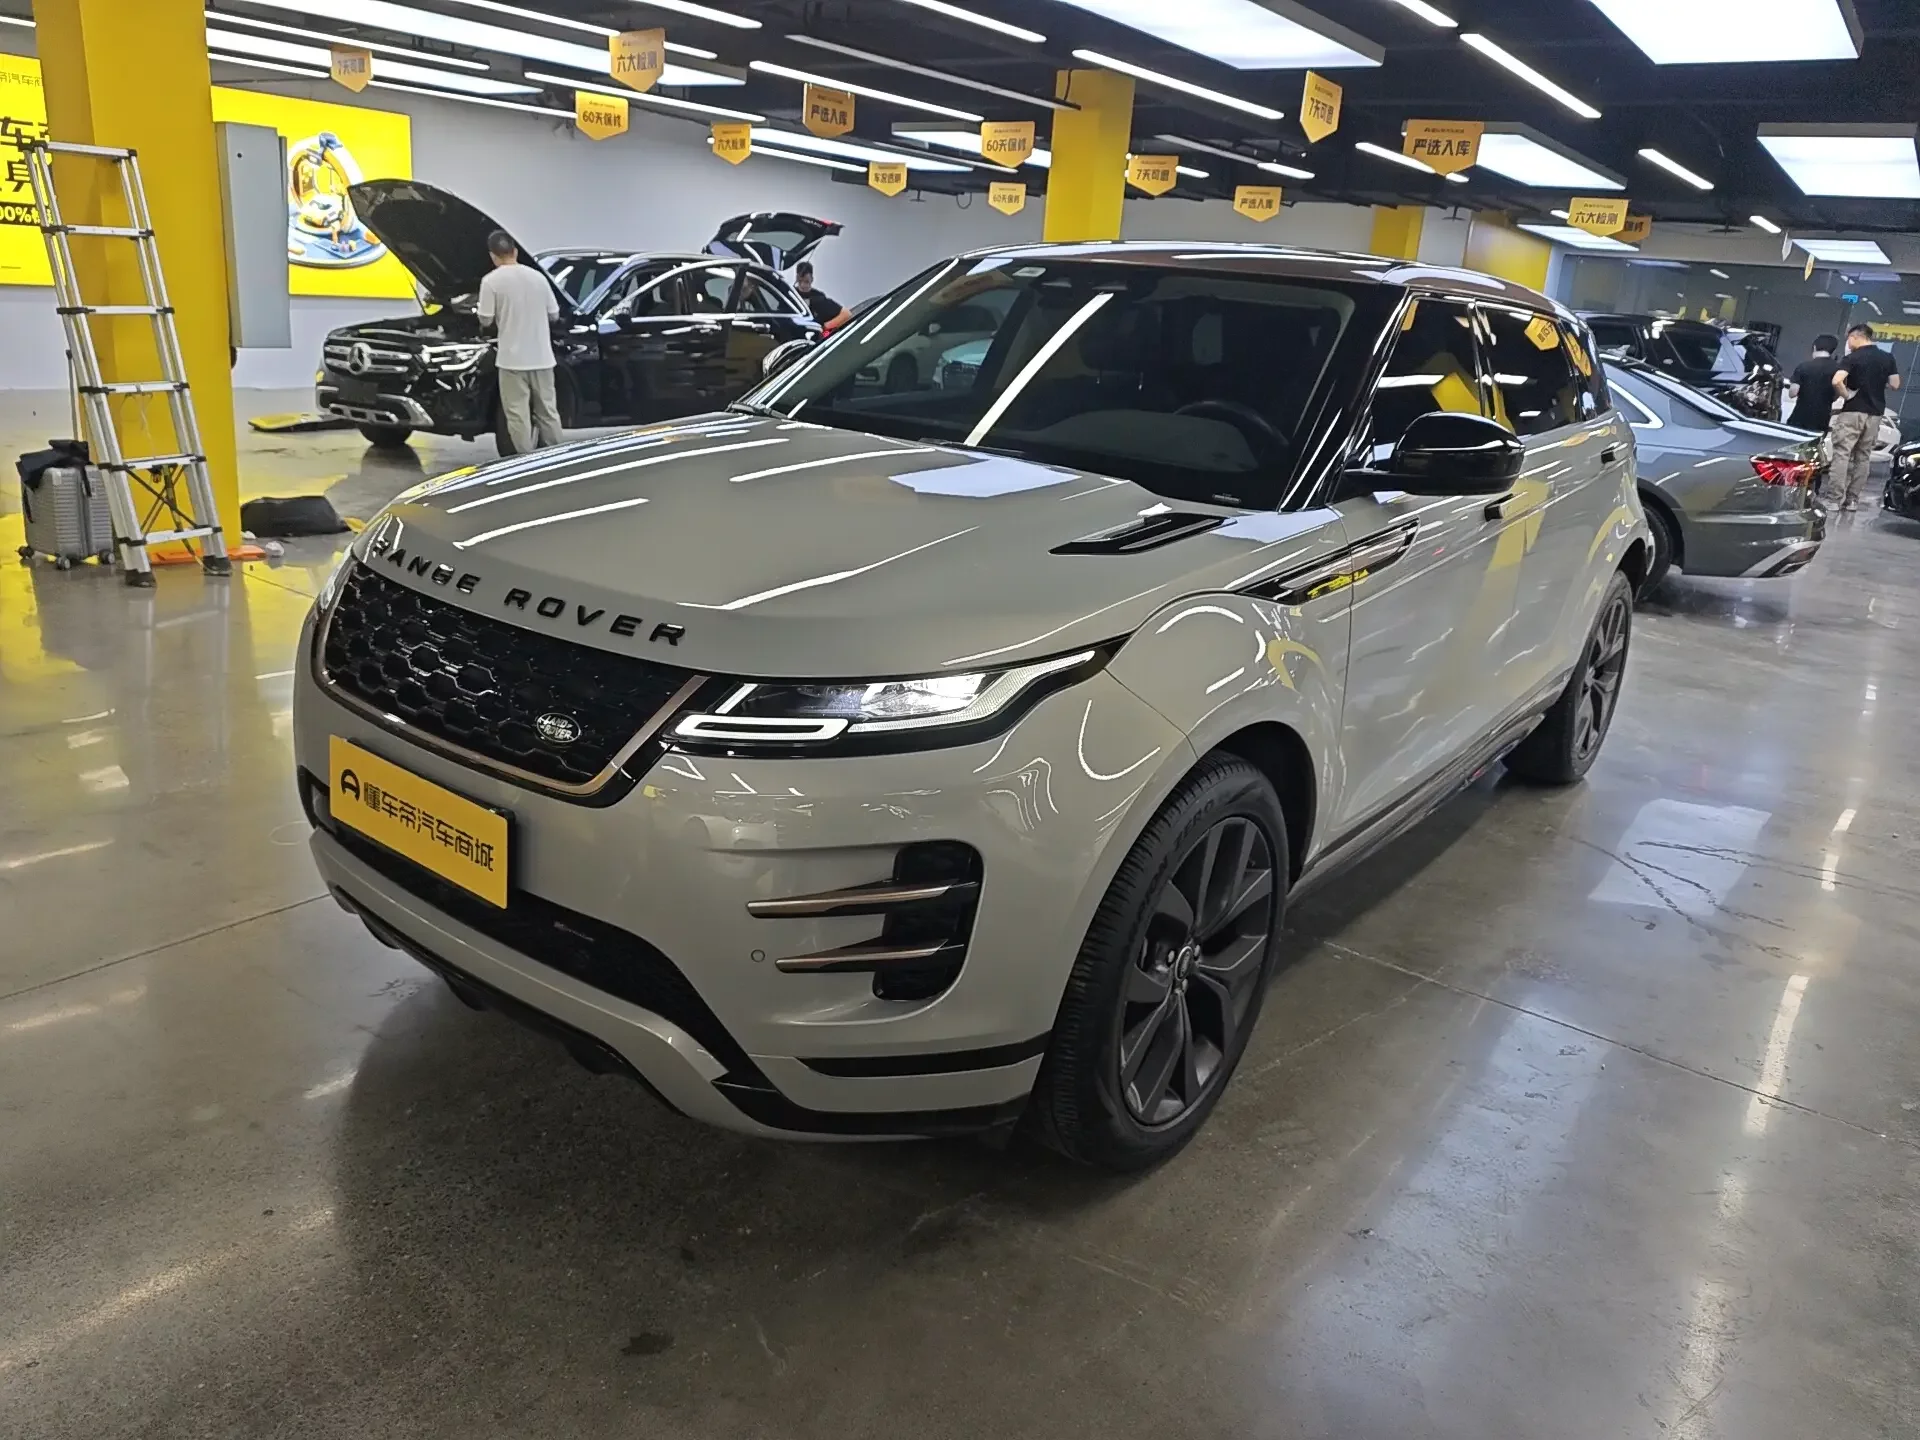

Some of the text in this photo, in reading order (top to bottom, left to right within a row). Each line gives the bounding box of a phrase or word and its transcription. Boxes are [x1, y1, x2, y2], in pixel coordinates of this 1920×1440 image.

[582, 110, 622, 128] 60天保修
[986, 137, 1027, 152] 60天保修
[1411, 138, 1471, 156] 严选入库
[1574, 210, 1619, 225] 六大检测
[373, 537, 686, 647] RANGE ROVER
[543, 724, 573, 740] ROVER
[363, 781, 494, 872] 懂车帝汽车商城
